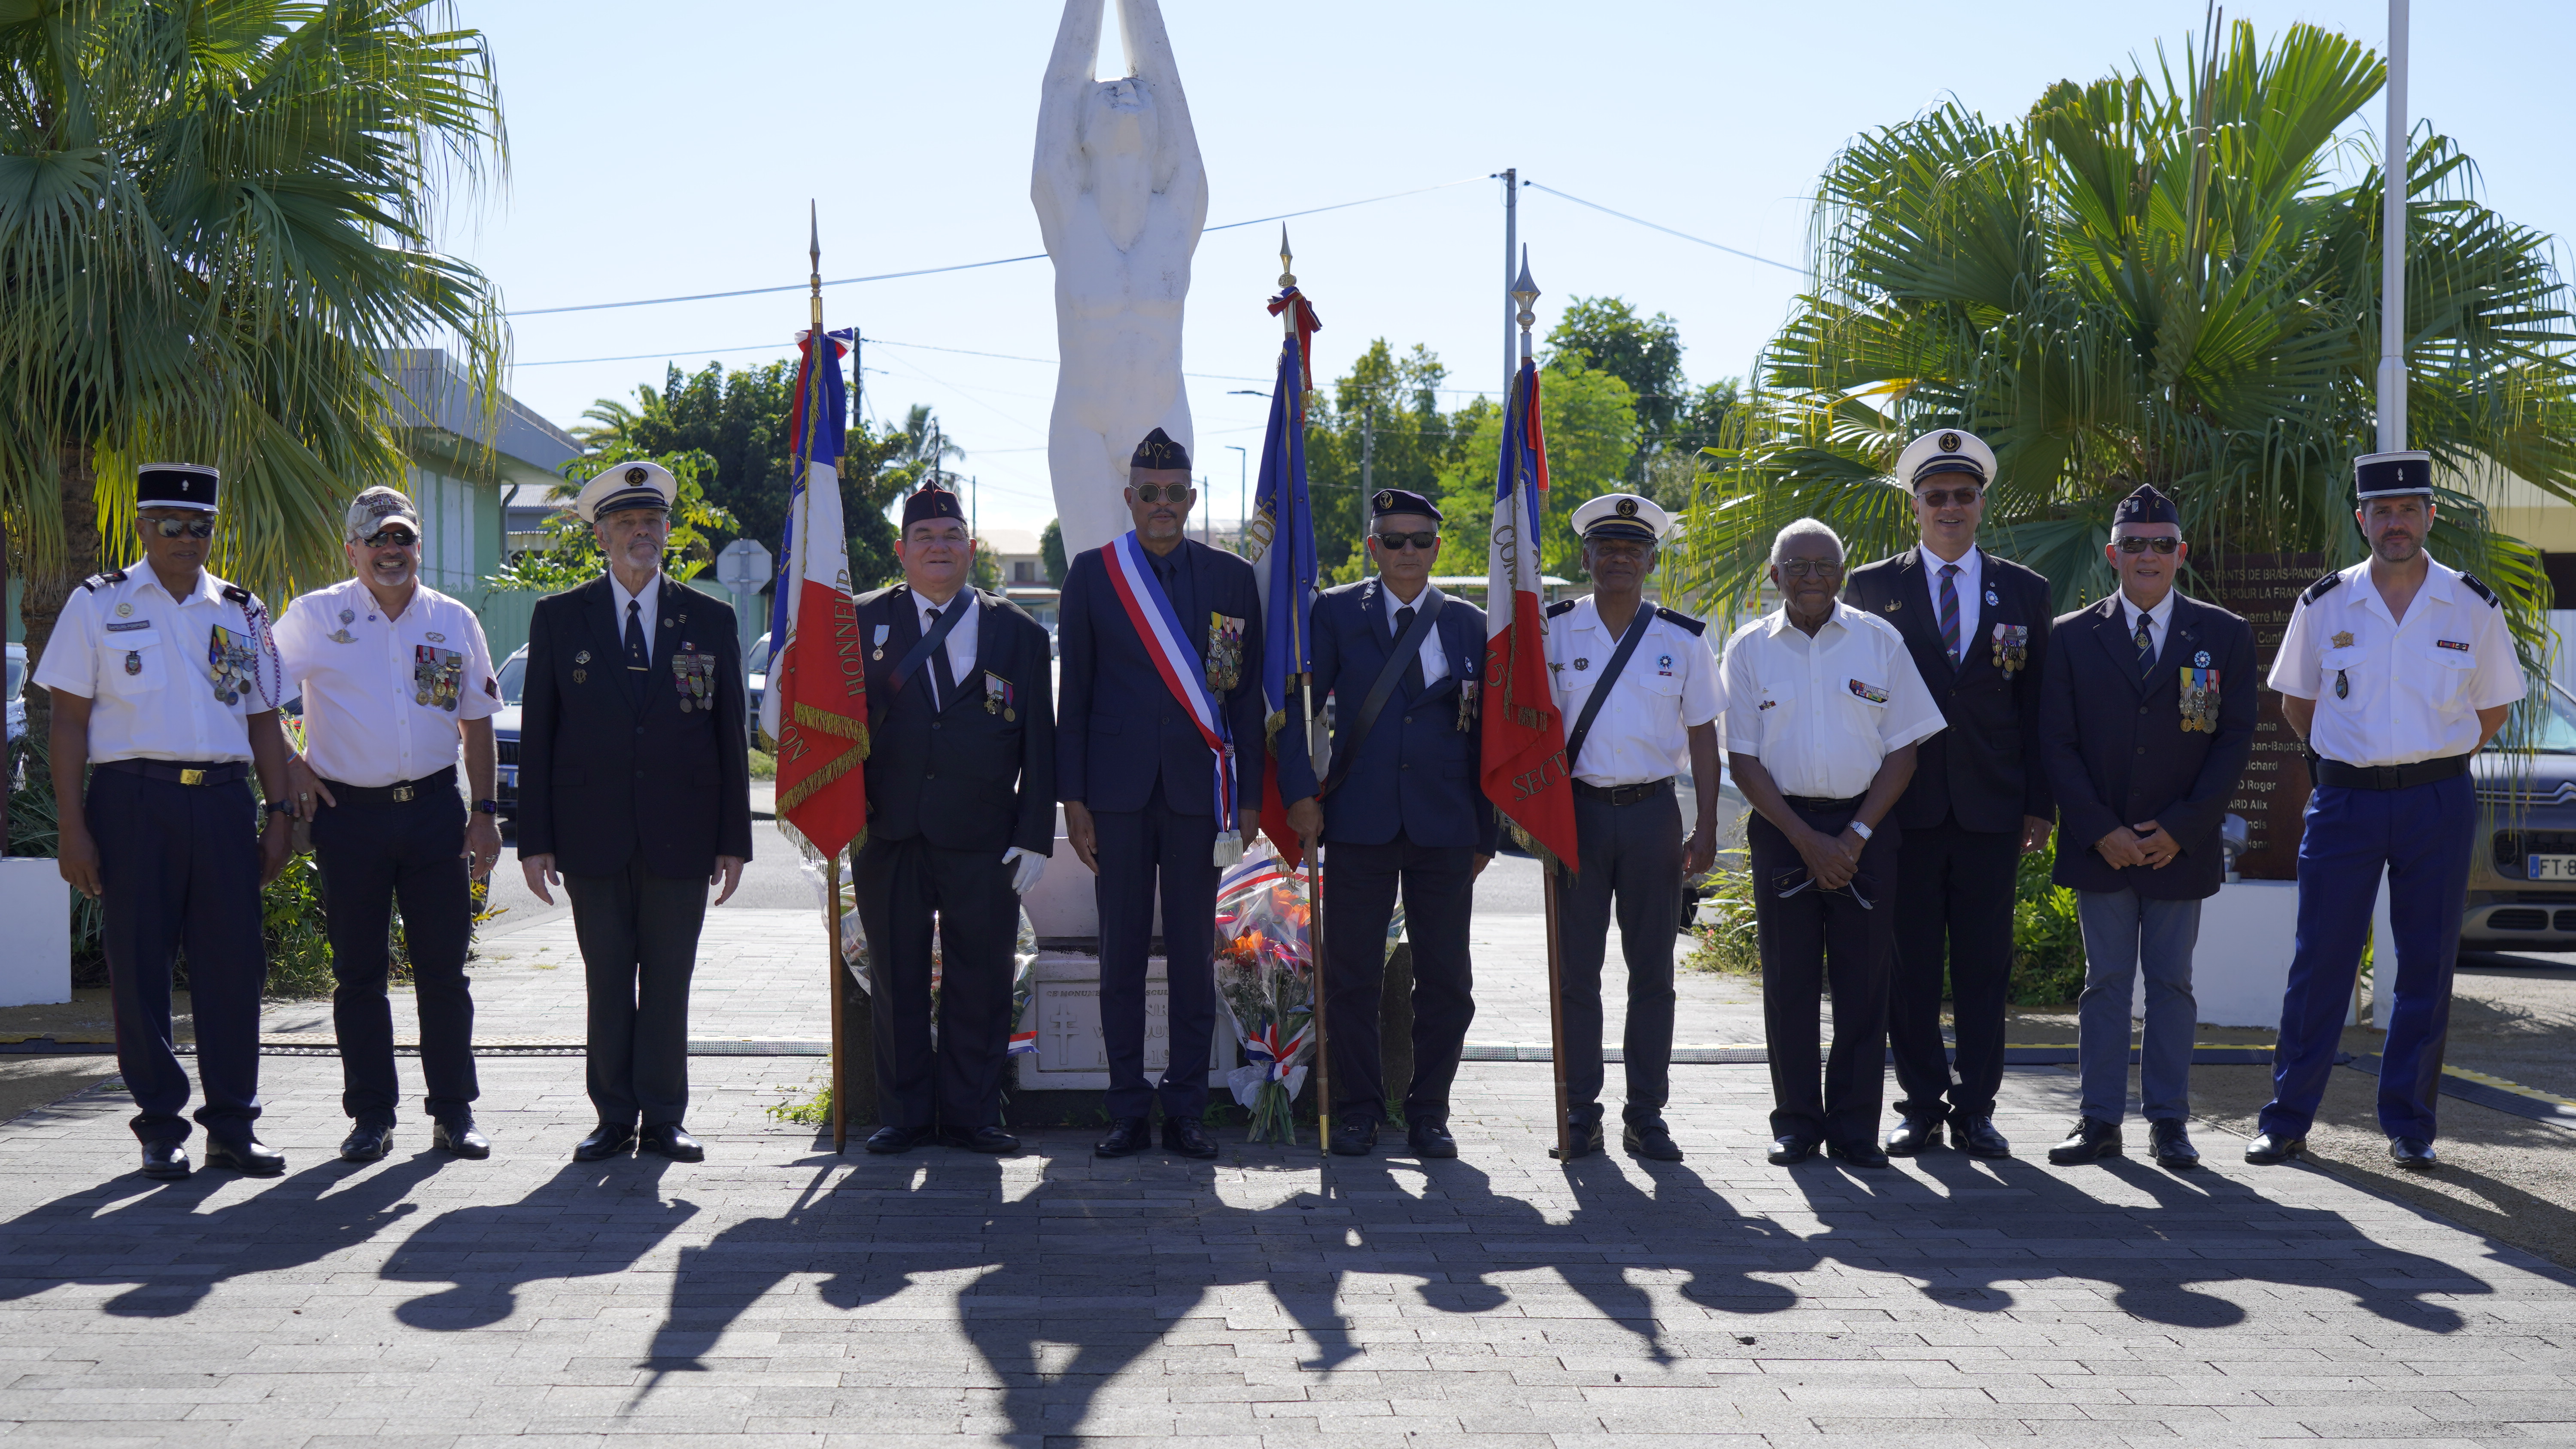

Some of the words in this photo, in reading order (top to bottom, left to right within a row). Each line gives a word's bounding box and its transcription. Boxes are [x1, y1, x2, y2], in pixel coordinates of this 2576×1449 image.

[2249, 569, 2260, 580] DE
[2233, 588, 2256, 599] POUR
[2260, 588, 2271, 599] LA
[2255, 721, 2277, 731] ania
[2251, 742, 2306, 752] ean-Baptist
[2246, 761, 2278, 770] ichard
[2248, 780, 2276, 792] Roger
[2250, 800, 2267, 810] Alix
[2248, 819, 2267, 830] ncis
